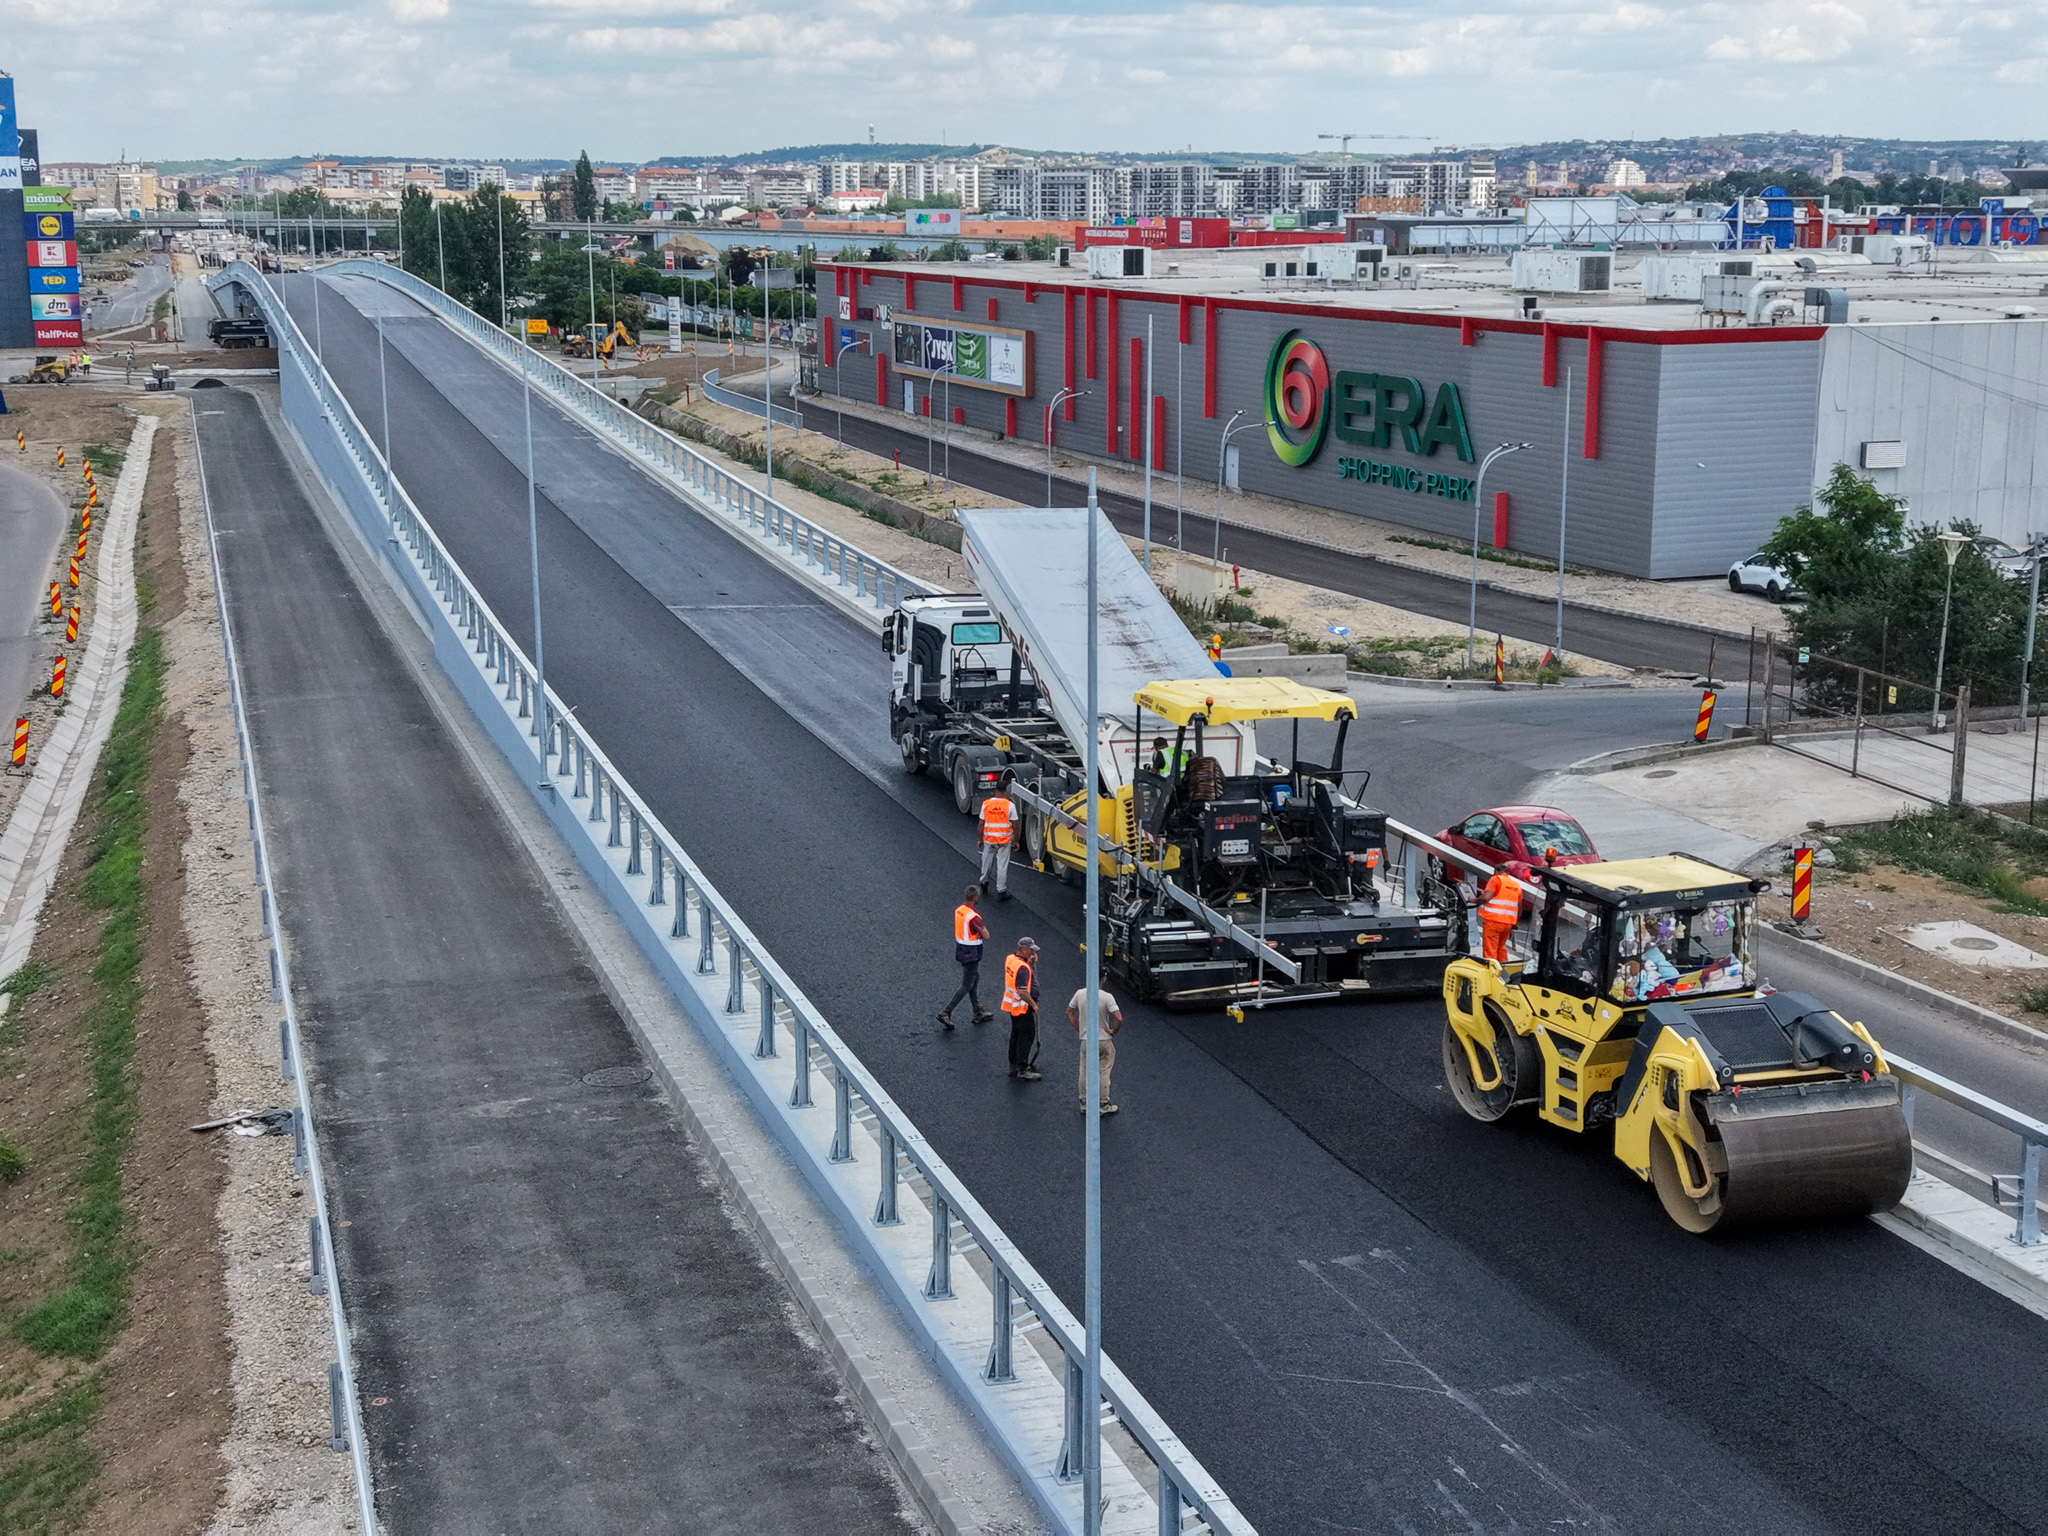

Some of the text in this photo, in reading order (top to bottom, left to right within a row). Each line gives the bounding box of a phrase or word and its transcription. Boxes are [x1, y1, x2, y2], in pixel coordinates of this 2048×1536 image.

[48, 299, 66, 309] dm
[37, 329, 79, 338] HalfPrice
[931, 339, 954, 361] JYSK
[1336, 371, 1474, 463] ERA
[1337, 456, 1477, 501] SHOPPING PARK
[1684, 889, 1704, 897] BOMAG
